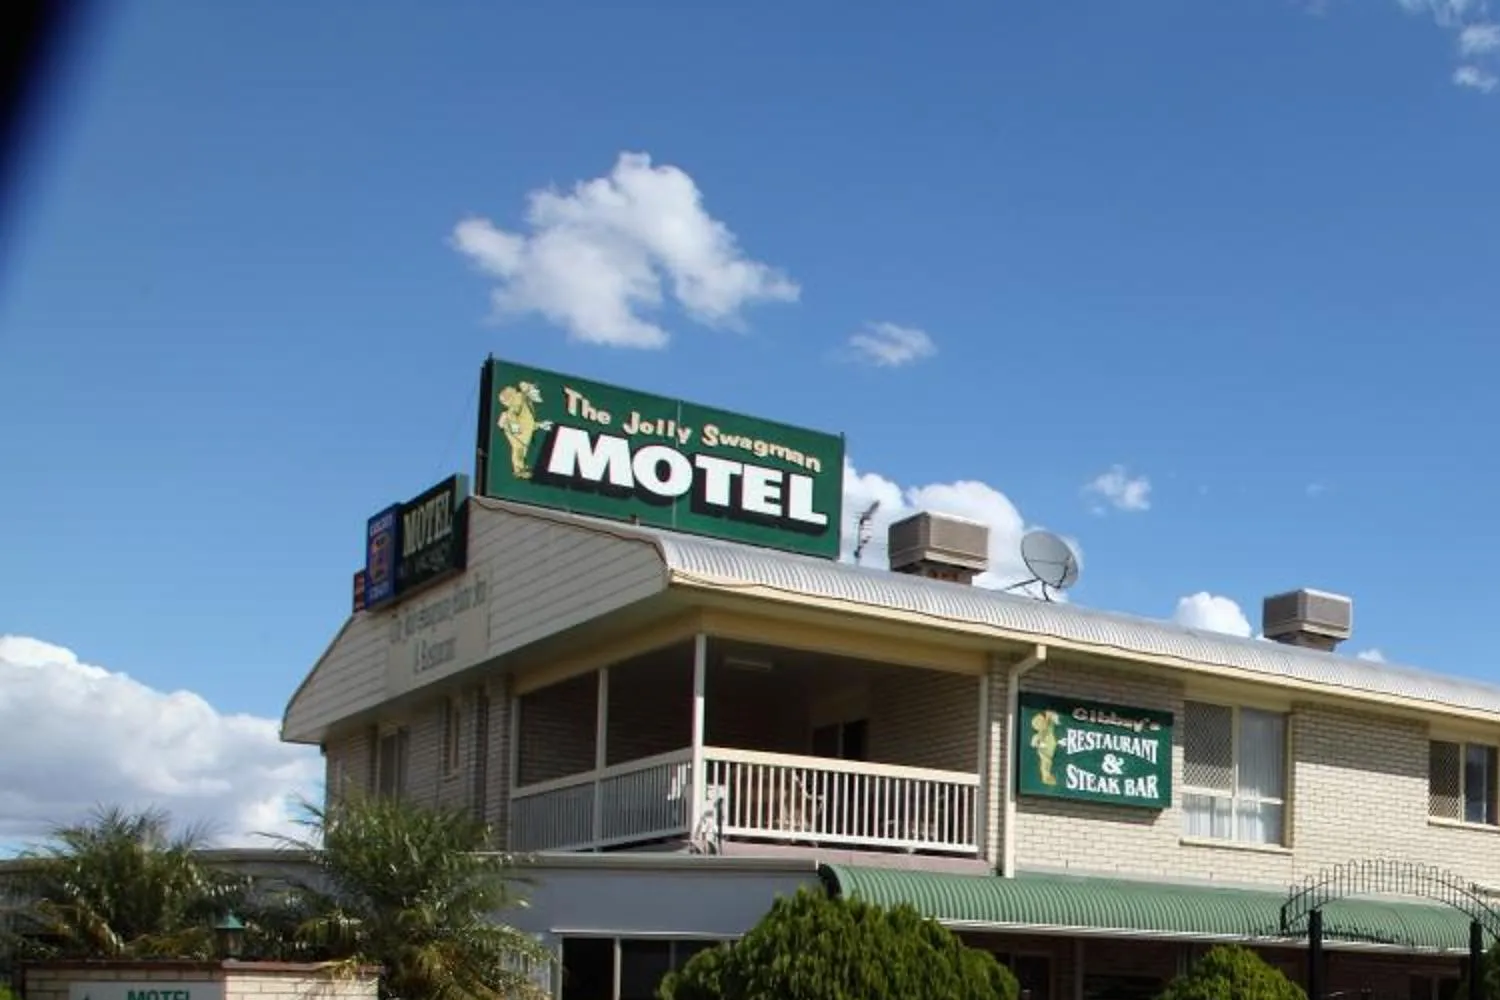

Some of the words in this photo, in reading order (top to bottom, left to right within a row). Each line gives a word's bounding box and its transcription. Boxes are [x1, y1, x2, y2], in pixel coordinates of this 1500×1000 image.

[564, 386, 612, 426] The
[623, 411, 692, 445] Jolly
[701, 424, 822, 473] Swagman
[547, 425, 828, 526] MOTEL
[402, 490, 453, 557] MOTEL
[1066, 728, 1160, 765] RESTAURANT
[1102, 753, 1125, 775] &
[1065, 763, 1121, 795] STEAK
[1124, 774, 1160, 799] BAR
